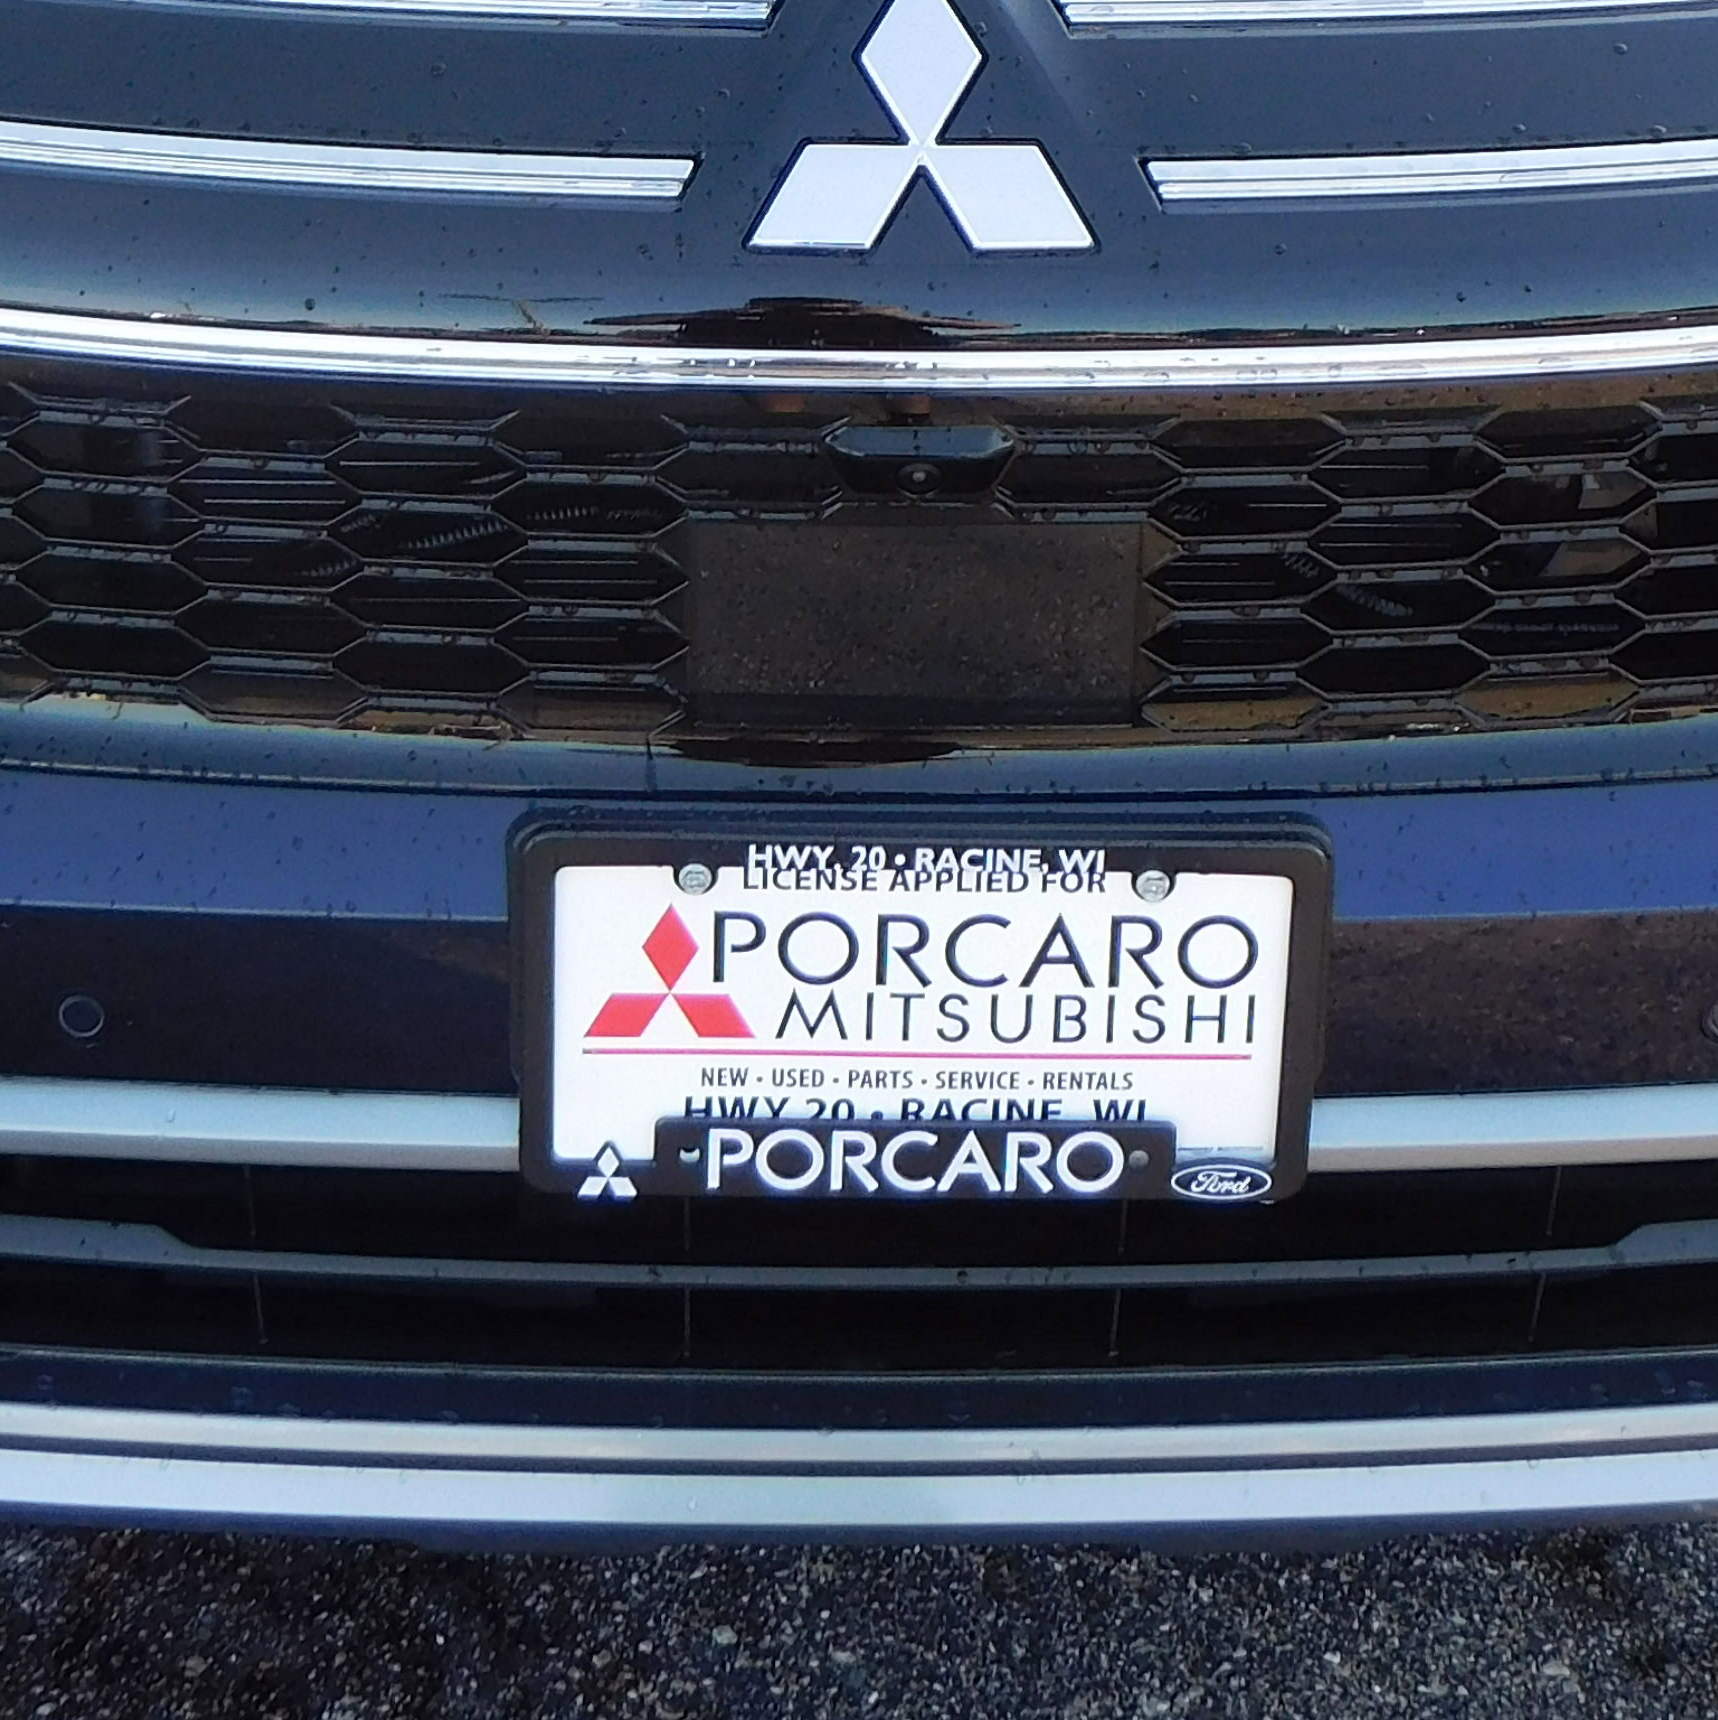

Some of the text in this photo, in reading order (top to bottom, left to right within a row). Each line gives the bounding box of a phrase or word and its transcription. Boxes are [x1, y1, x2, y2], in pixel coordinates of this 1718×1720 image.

[851, 846, 886, 871] 20
[1059, 849, 1107, 875] WI
[743, 868, 1107, 894] LICENSE APPLIED FOR
[713, 910, 1259, 990] PORCARO
[774, 987, 1256, 1044] MITSUBISHI
[700, 1067, 1134, 1092] NEW USED PARTS SERVICE RENTALS
[706, 1127, 1126, 1194] PORCARO
[1190, 1170, 1252, 1194] Ford
